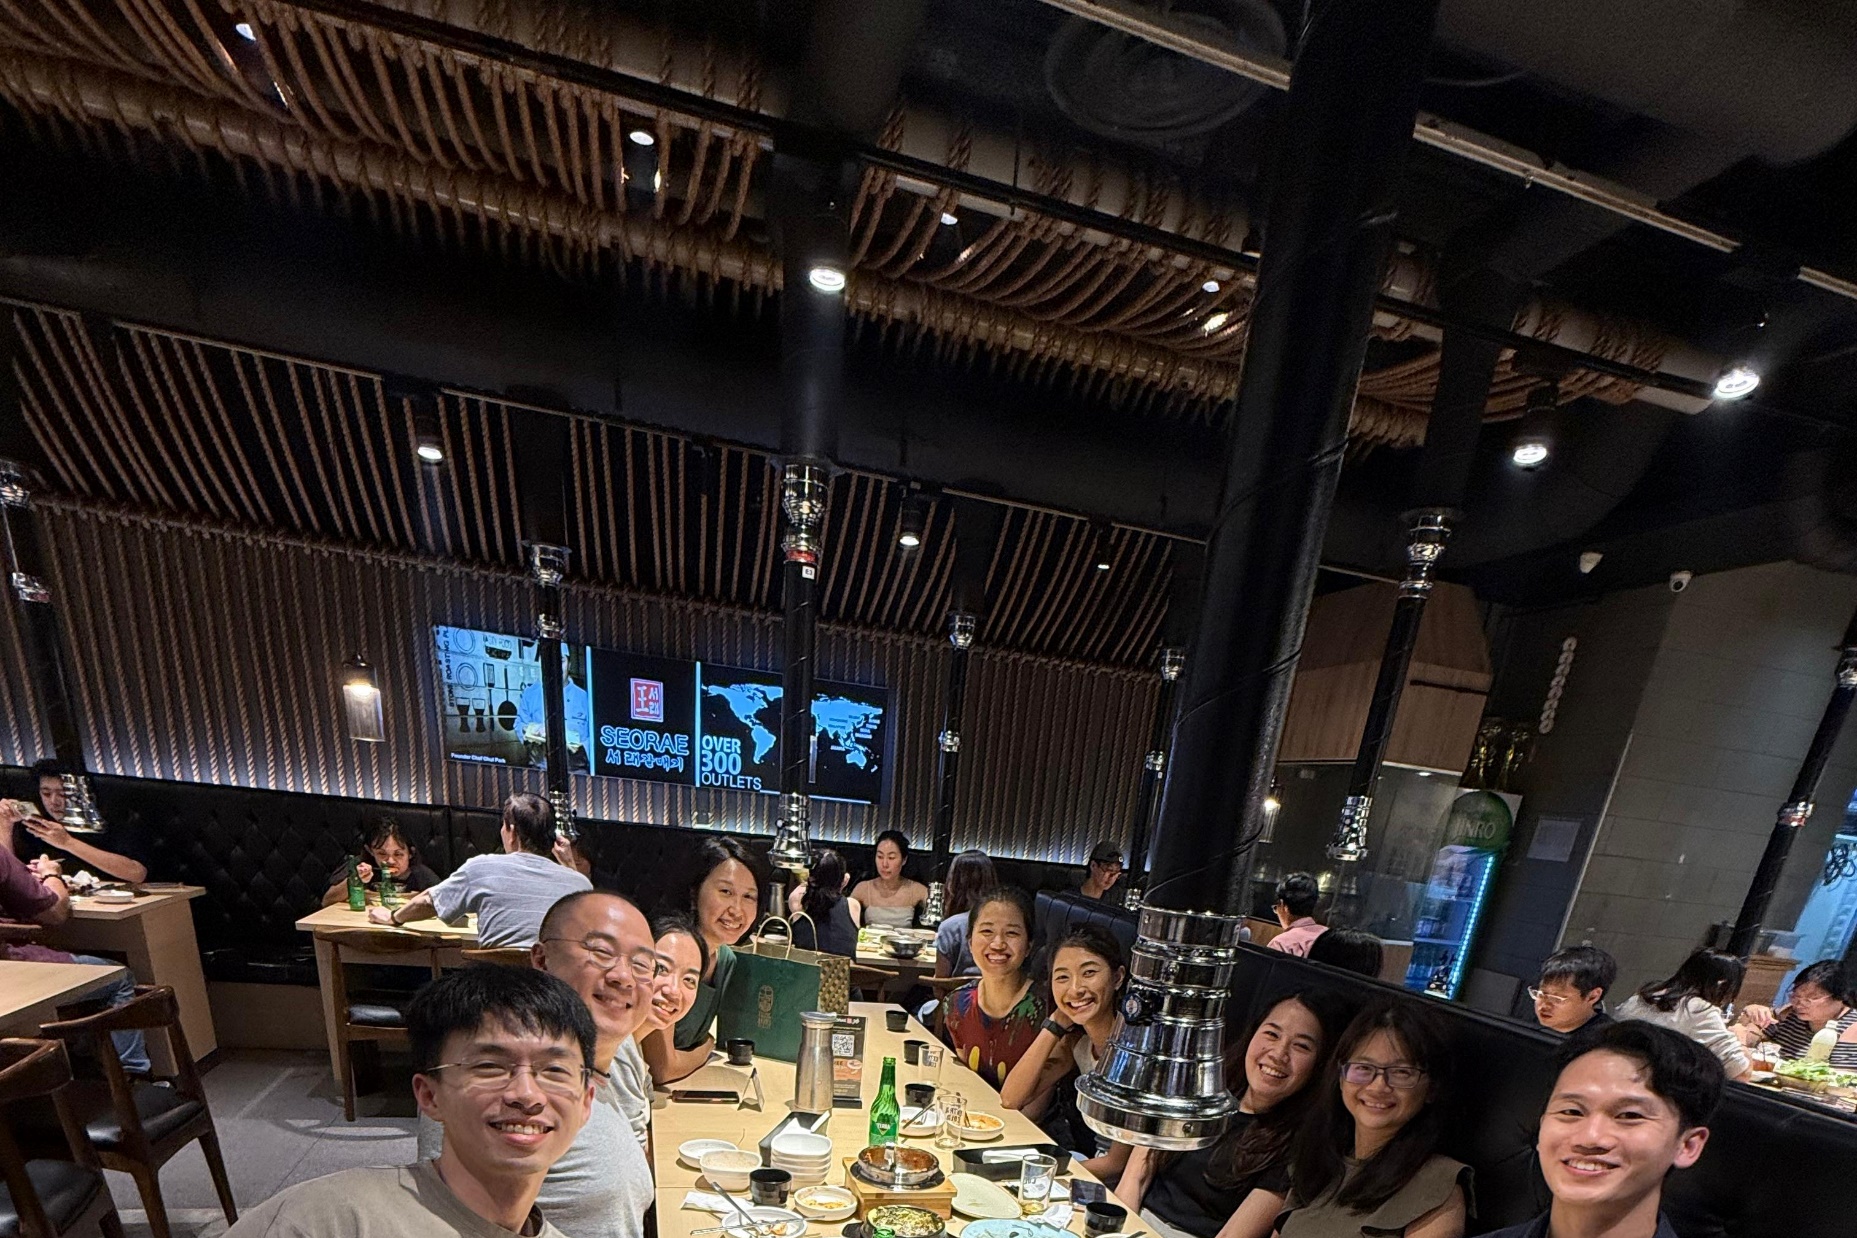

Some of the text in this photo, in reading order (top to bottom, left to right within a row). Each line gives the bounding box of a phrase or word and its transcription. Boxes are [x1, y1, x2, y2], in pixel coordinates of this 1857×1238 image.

[600, 725, 689, 755] SEORAE
[702, 735, 741, 754] OVER
[701, 750, 742, 775] 300
[701, 771, 762, 790] OUTLETS
